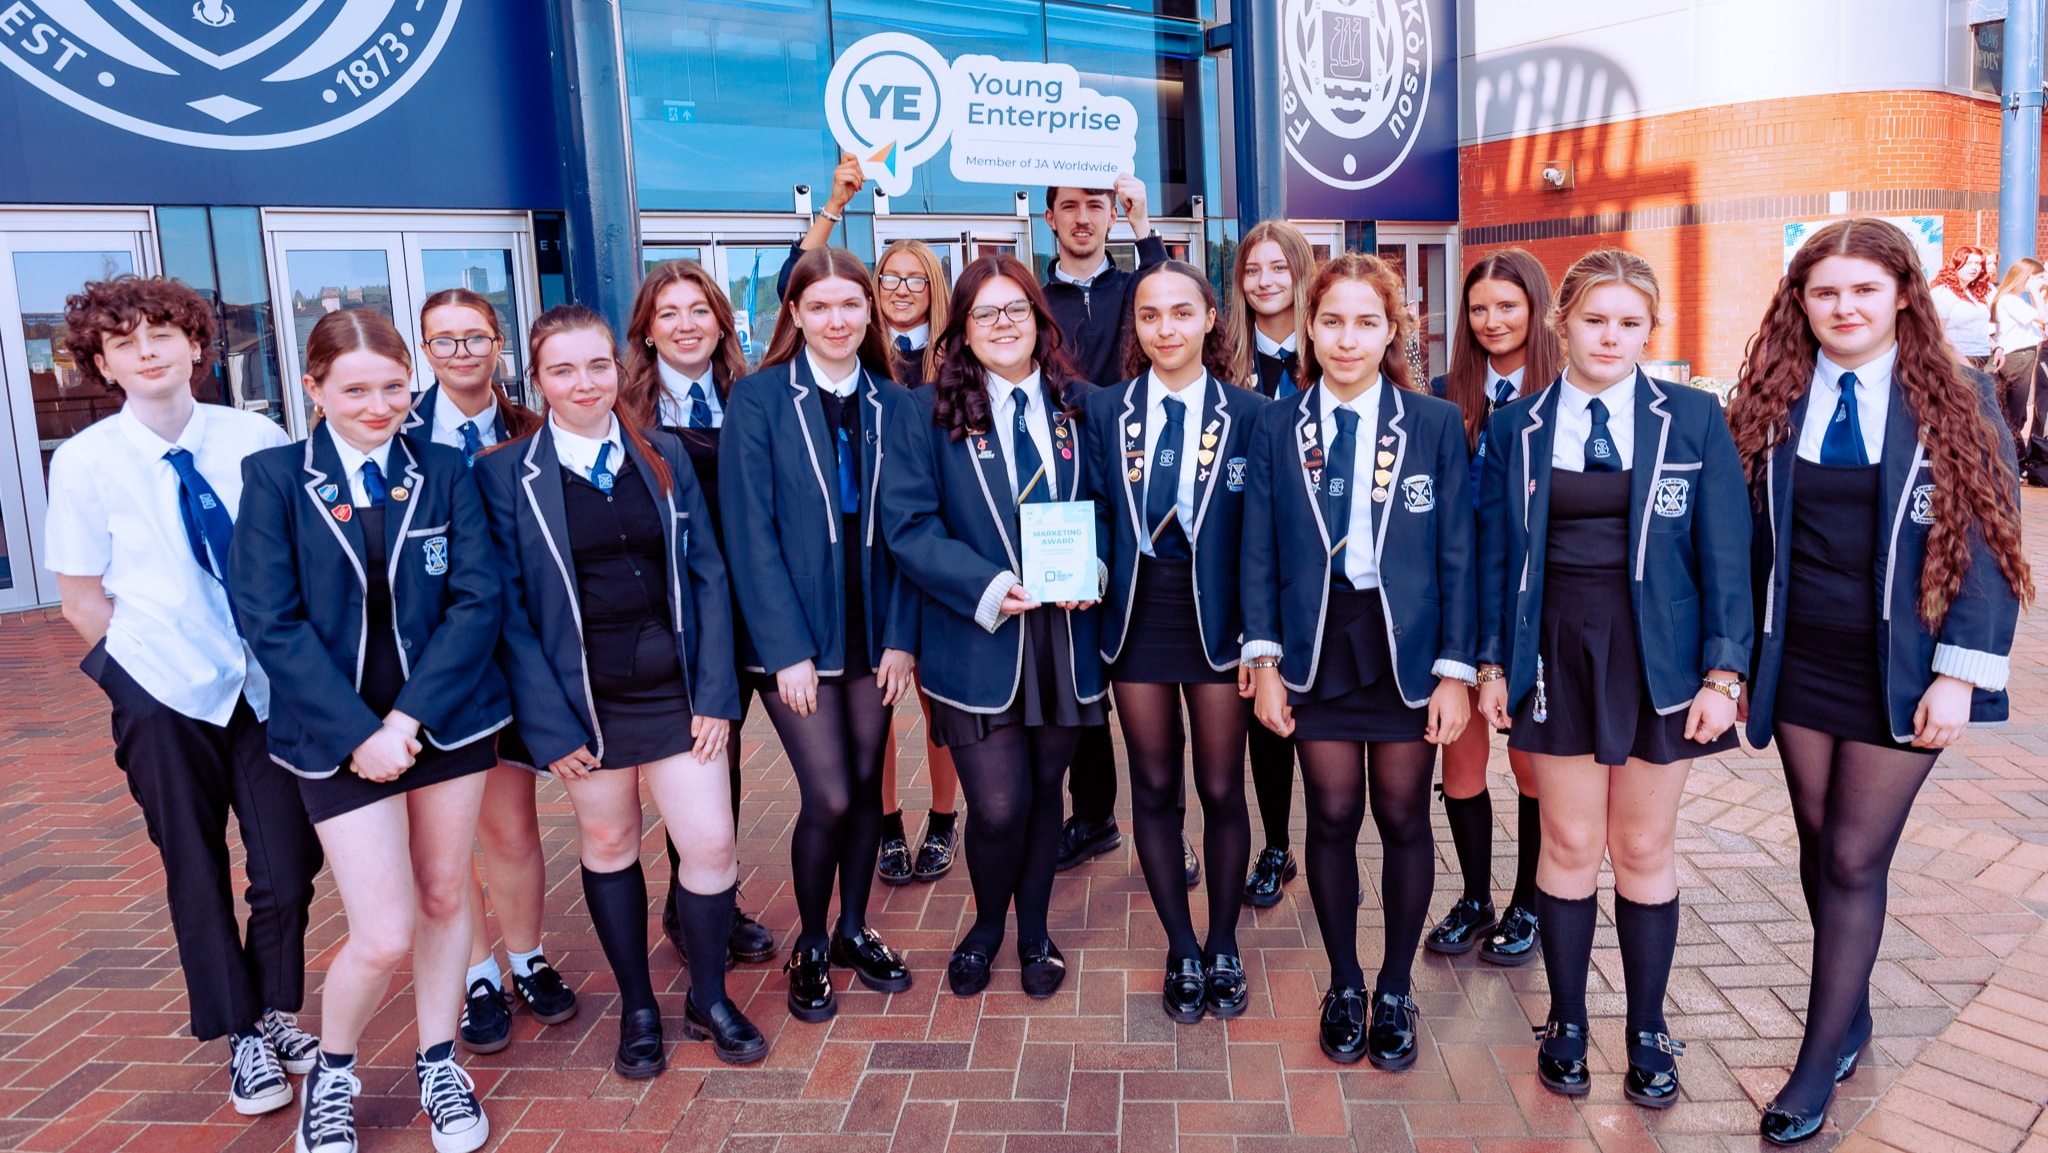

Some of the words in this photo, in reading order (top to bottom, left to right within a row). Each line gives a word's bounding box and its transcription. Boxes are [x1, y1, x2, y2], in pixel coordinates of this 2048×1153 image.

[0, 1, 88, 72] EST
[336, 32, 409, 98] 1873
[1388, 0, 1425, 140] Kòrsou
[859, 84, 921, 121] YE
[968, 72, 1062, 103] Young
[968, 102, 1121, 133] Enterprise
[966, 155, 1015, 168] Member
[1020, 157, 1032, 168] of
[1034, 159, 1049, 170] JA
[1052, 160, 1118, 173] Worldwide
[1033, 529, 1082, 538] MARKETING
[1041, 538, 1074, 546] AWARD
